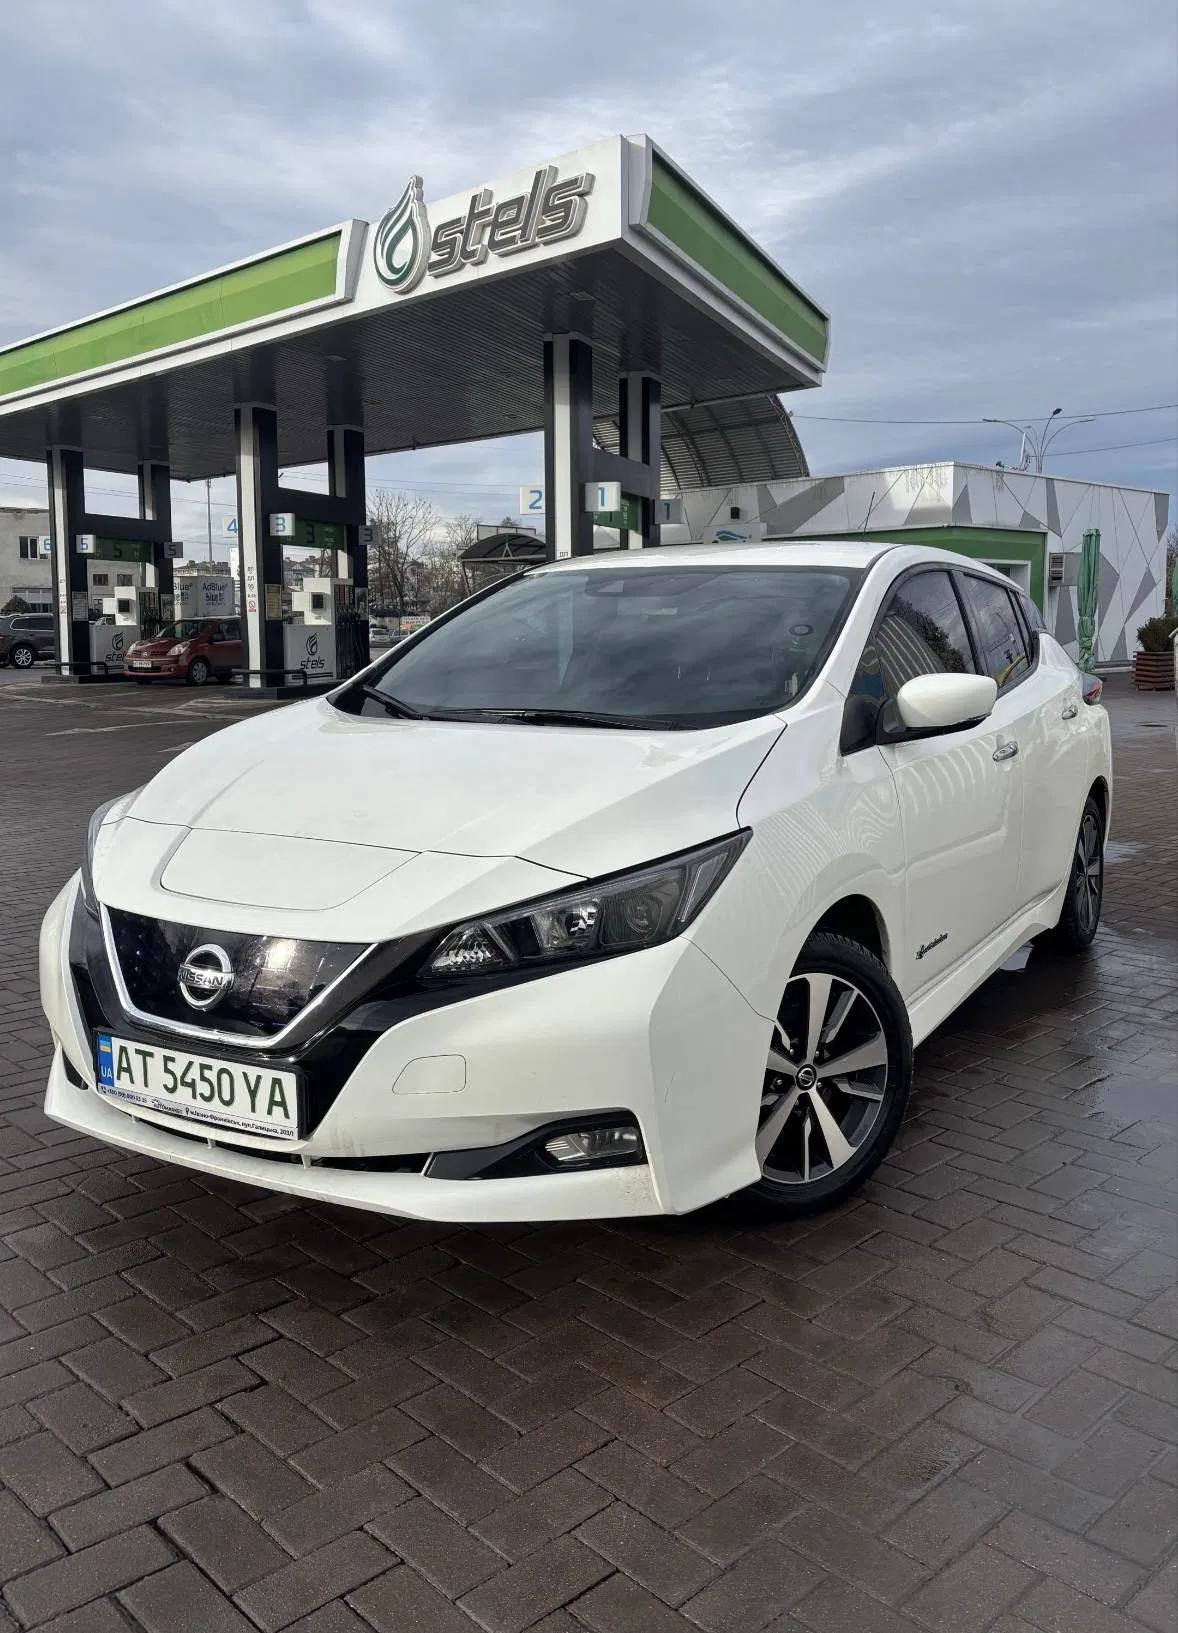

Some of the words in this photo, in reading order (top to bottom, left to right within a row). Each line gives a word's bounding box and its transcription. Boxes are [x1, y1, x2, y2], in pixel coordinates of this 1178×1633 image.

[427, 165, 596, 277] stels
[528, 490, 543, 510] 2
[597, 487, 605, 507] 1
[664, 502, 671, 520] 1
[227, 518, 238, 533] 4
[275, 516, 286, 533] 3
[306, 523, 315, 544] 3
[363, 527, 378, 542] 3
[80, 537, 89, 551] 5
[112, 541, 123, 558] 5
[168, 544, 177, 556] 5
[105, 651, 125, 661] stel
[300, 656, 325, 670] stels
[177, 967, 224, 987] NISSAN
[101, 1066, 113, 1079] UA
[116, 1045, 154, 1088] AT
[162, 1054, 235, 1107] 5450
[242, 1071, 290, 1120] YA
